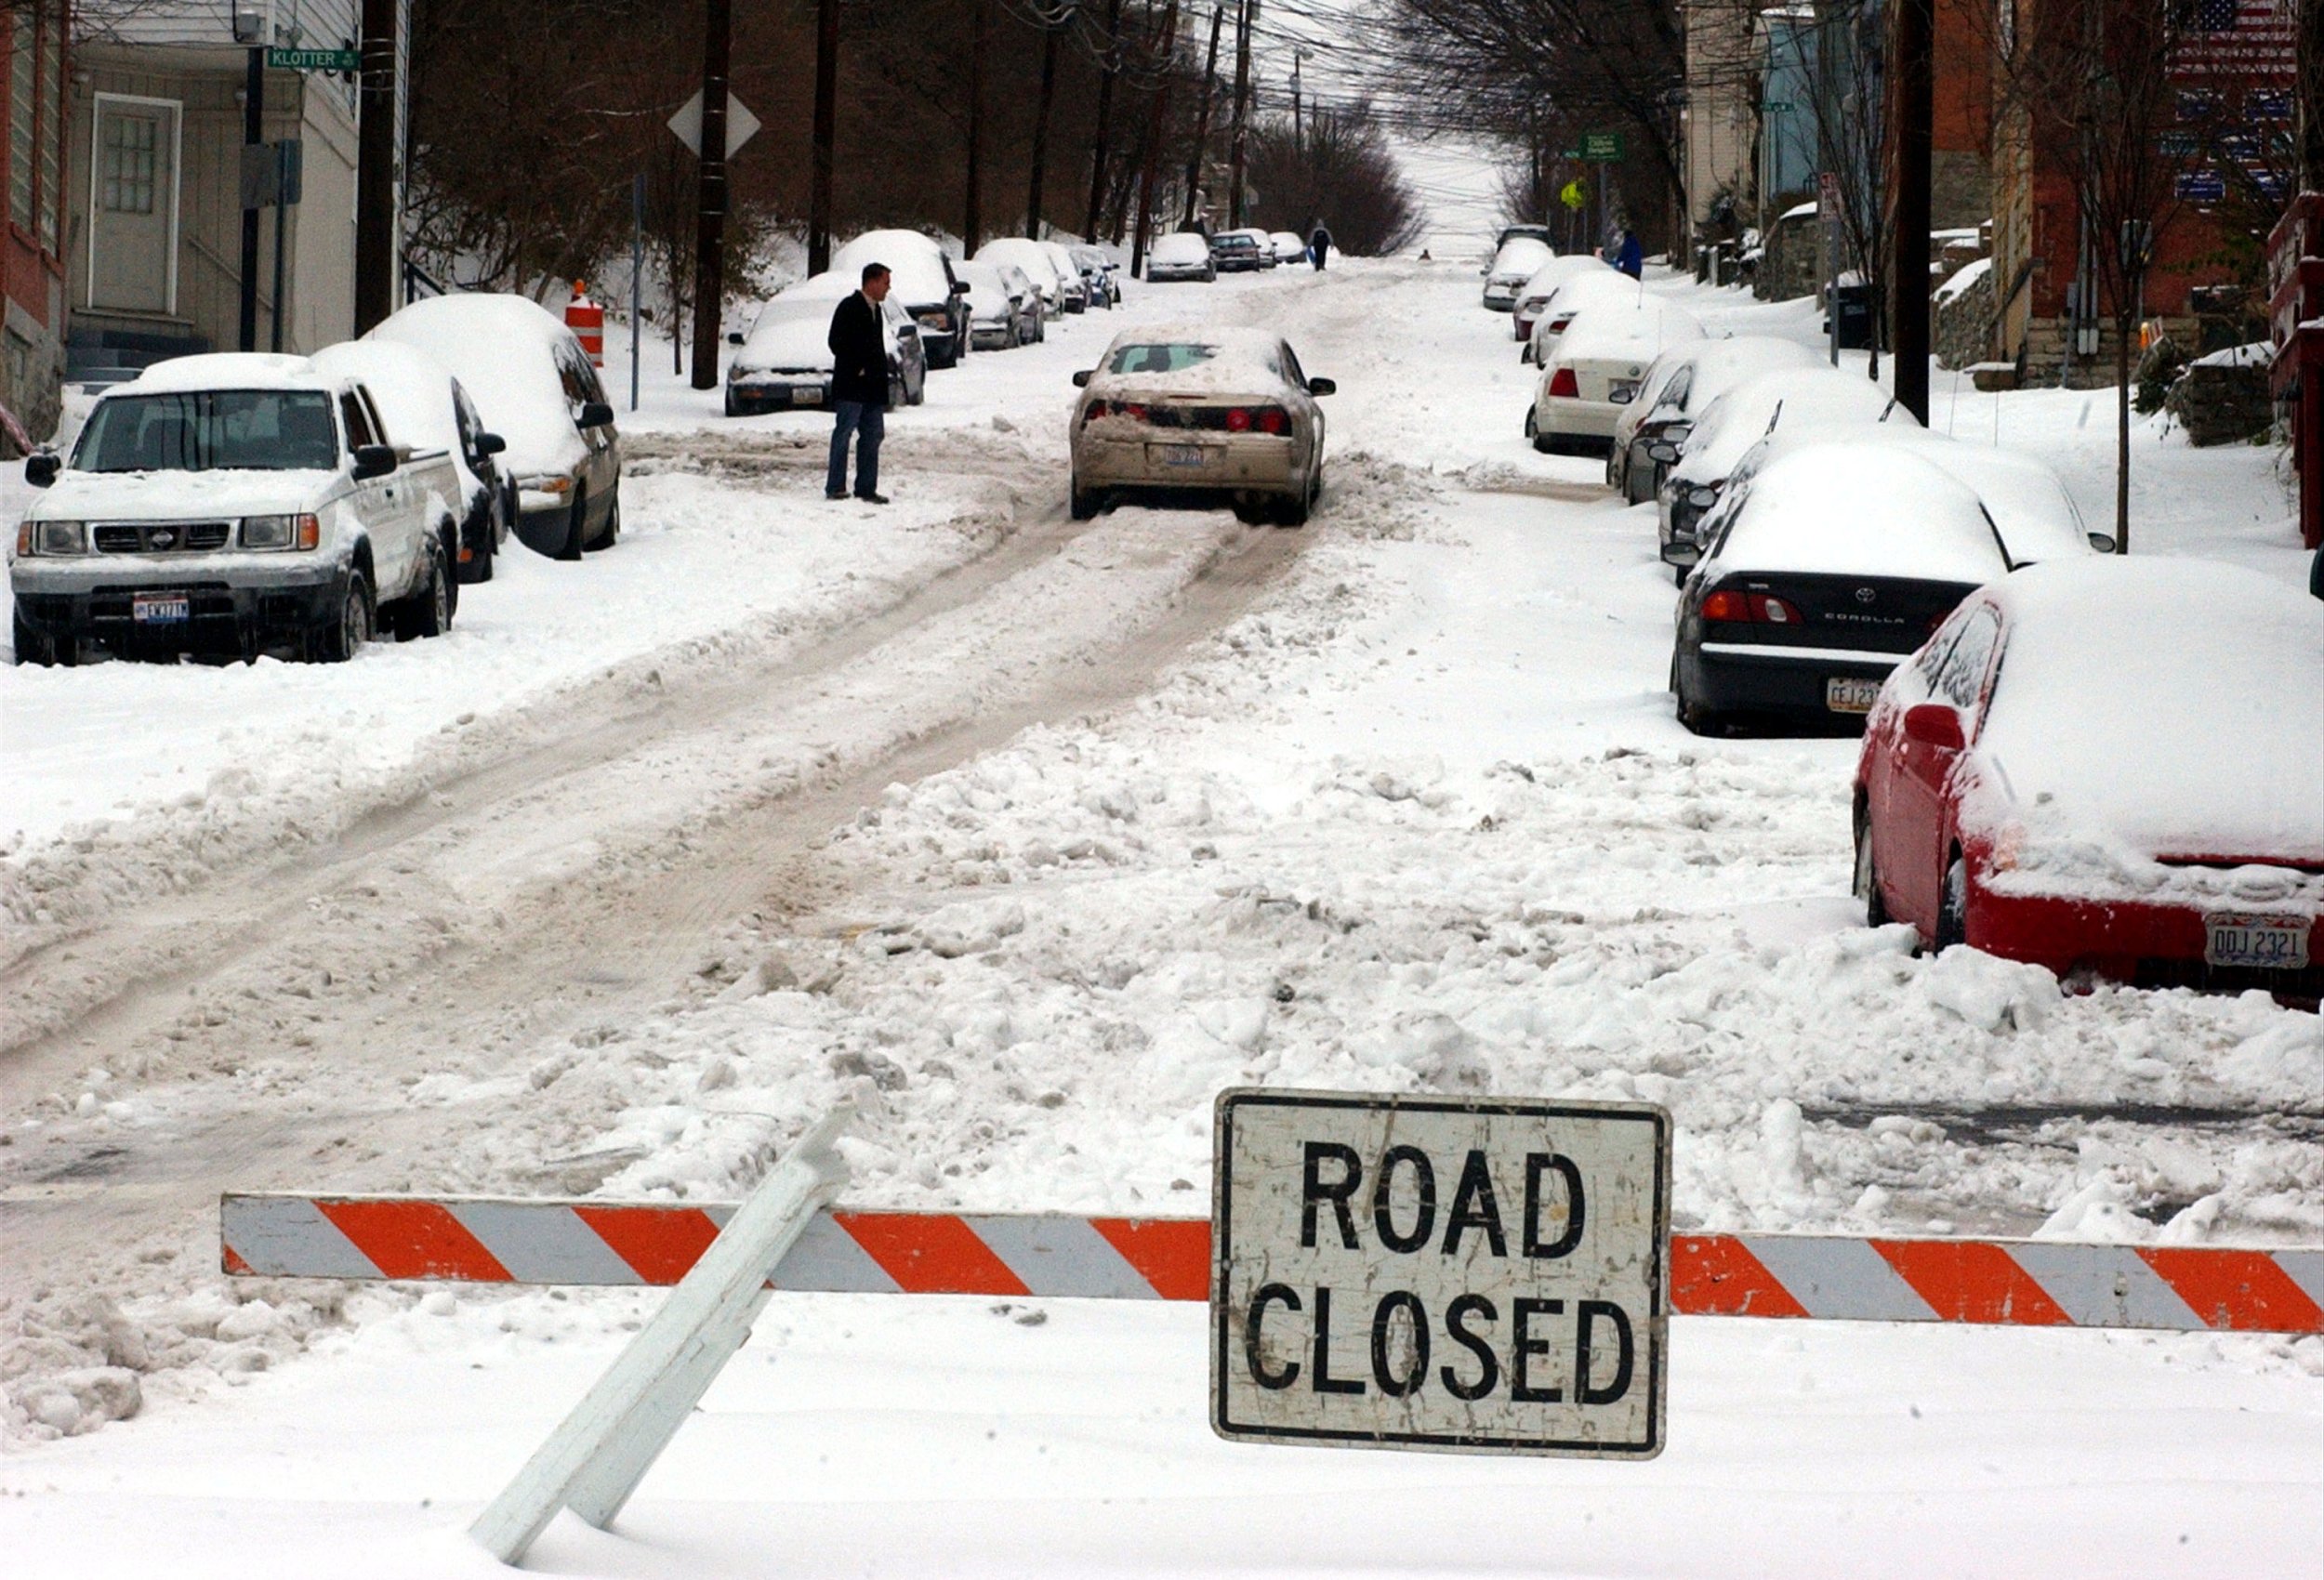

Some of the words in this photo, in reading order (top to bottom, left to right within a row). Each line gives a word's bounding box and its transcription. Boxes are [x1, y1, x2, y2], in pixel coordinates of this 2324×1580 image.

[272, 51, 335, 66] KLOTTER
[1824, 611, 1905, 625] COROLLA
[2254, 930, 2297, 957] 2321
[1301, 1141, 1586, 1258] ROAD
[1246, 1283, 1635, 1405] CLOSED
